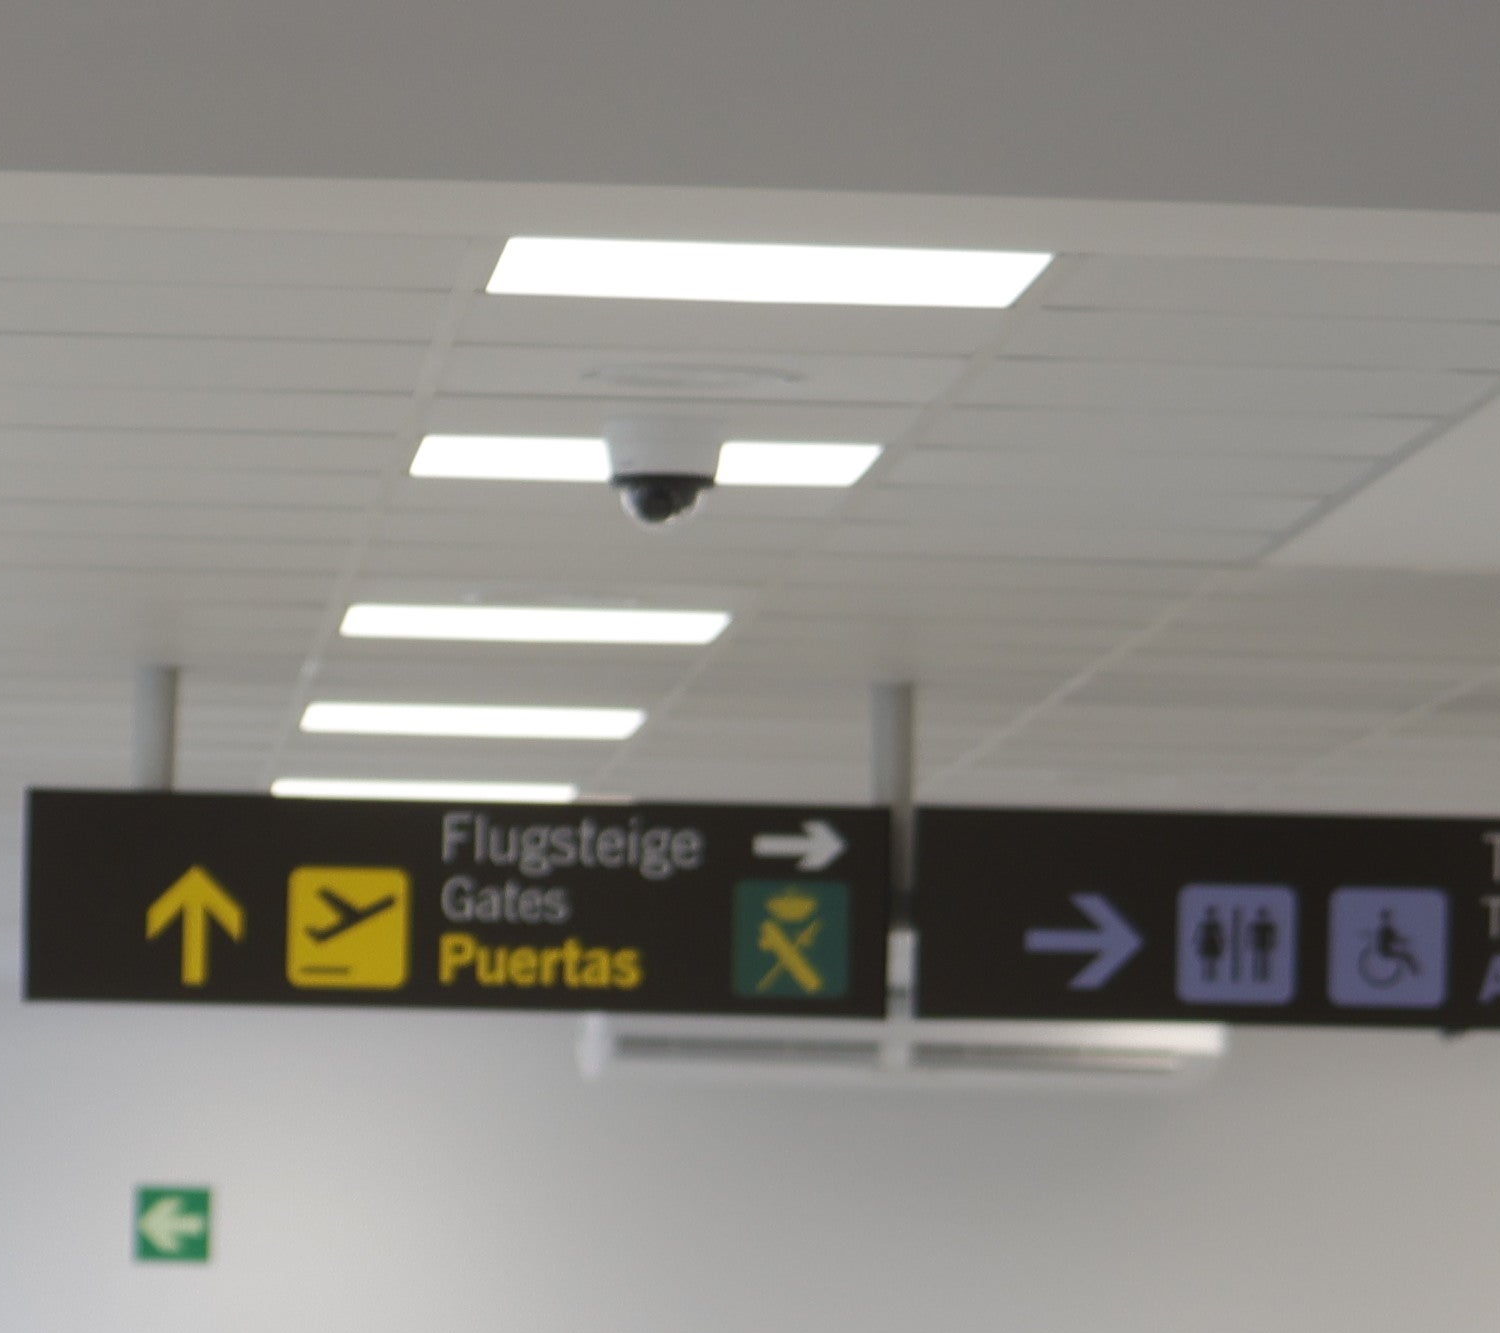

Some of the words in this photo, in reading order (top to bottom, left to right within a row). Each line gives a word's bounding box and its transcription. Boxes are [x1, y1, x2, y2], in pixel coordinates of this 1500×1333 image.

[441, 811, 704, 878] Flugsteige
[441, 875, 571, 923] Gates
[439, 933, 643, 988] Puertas
